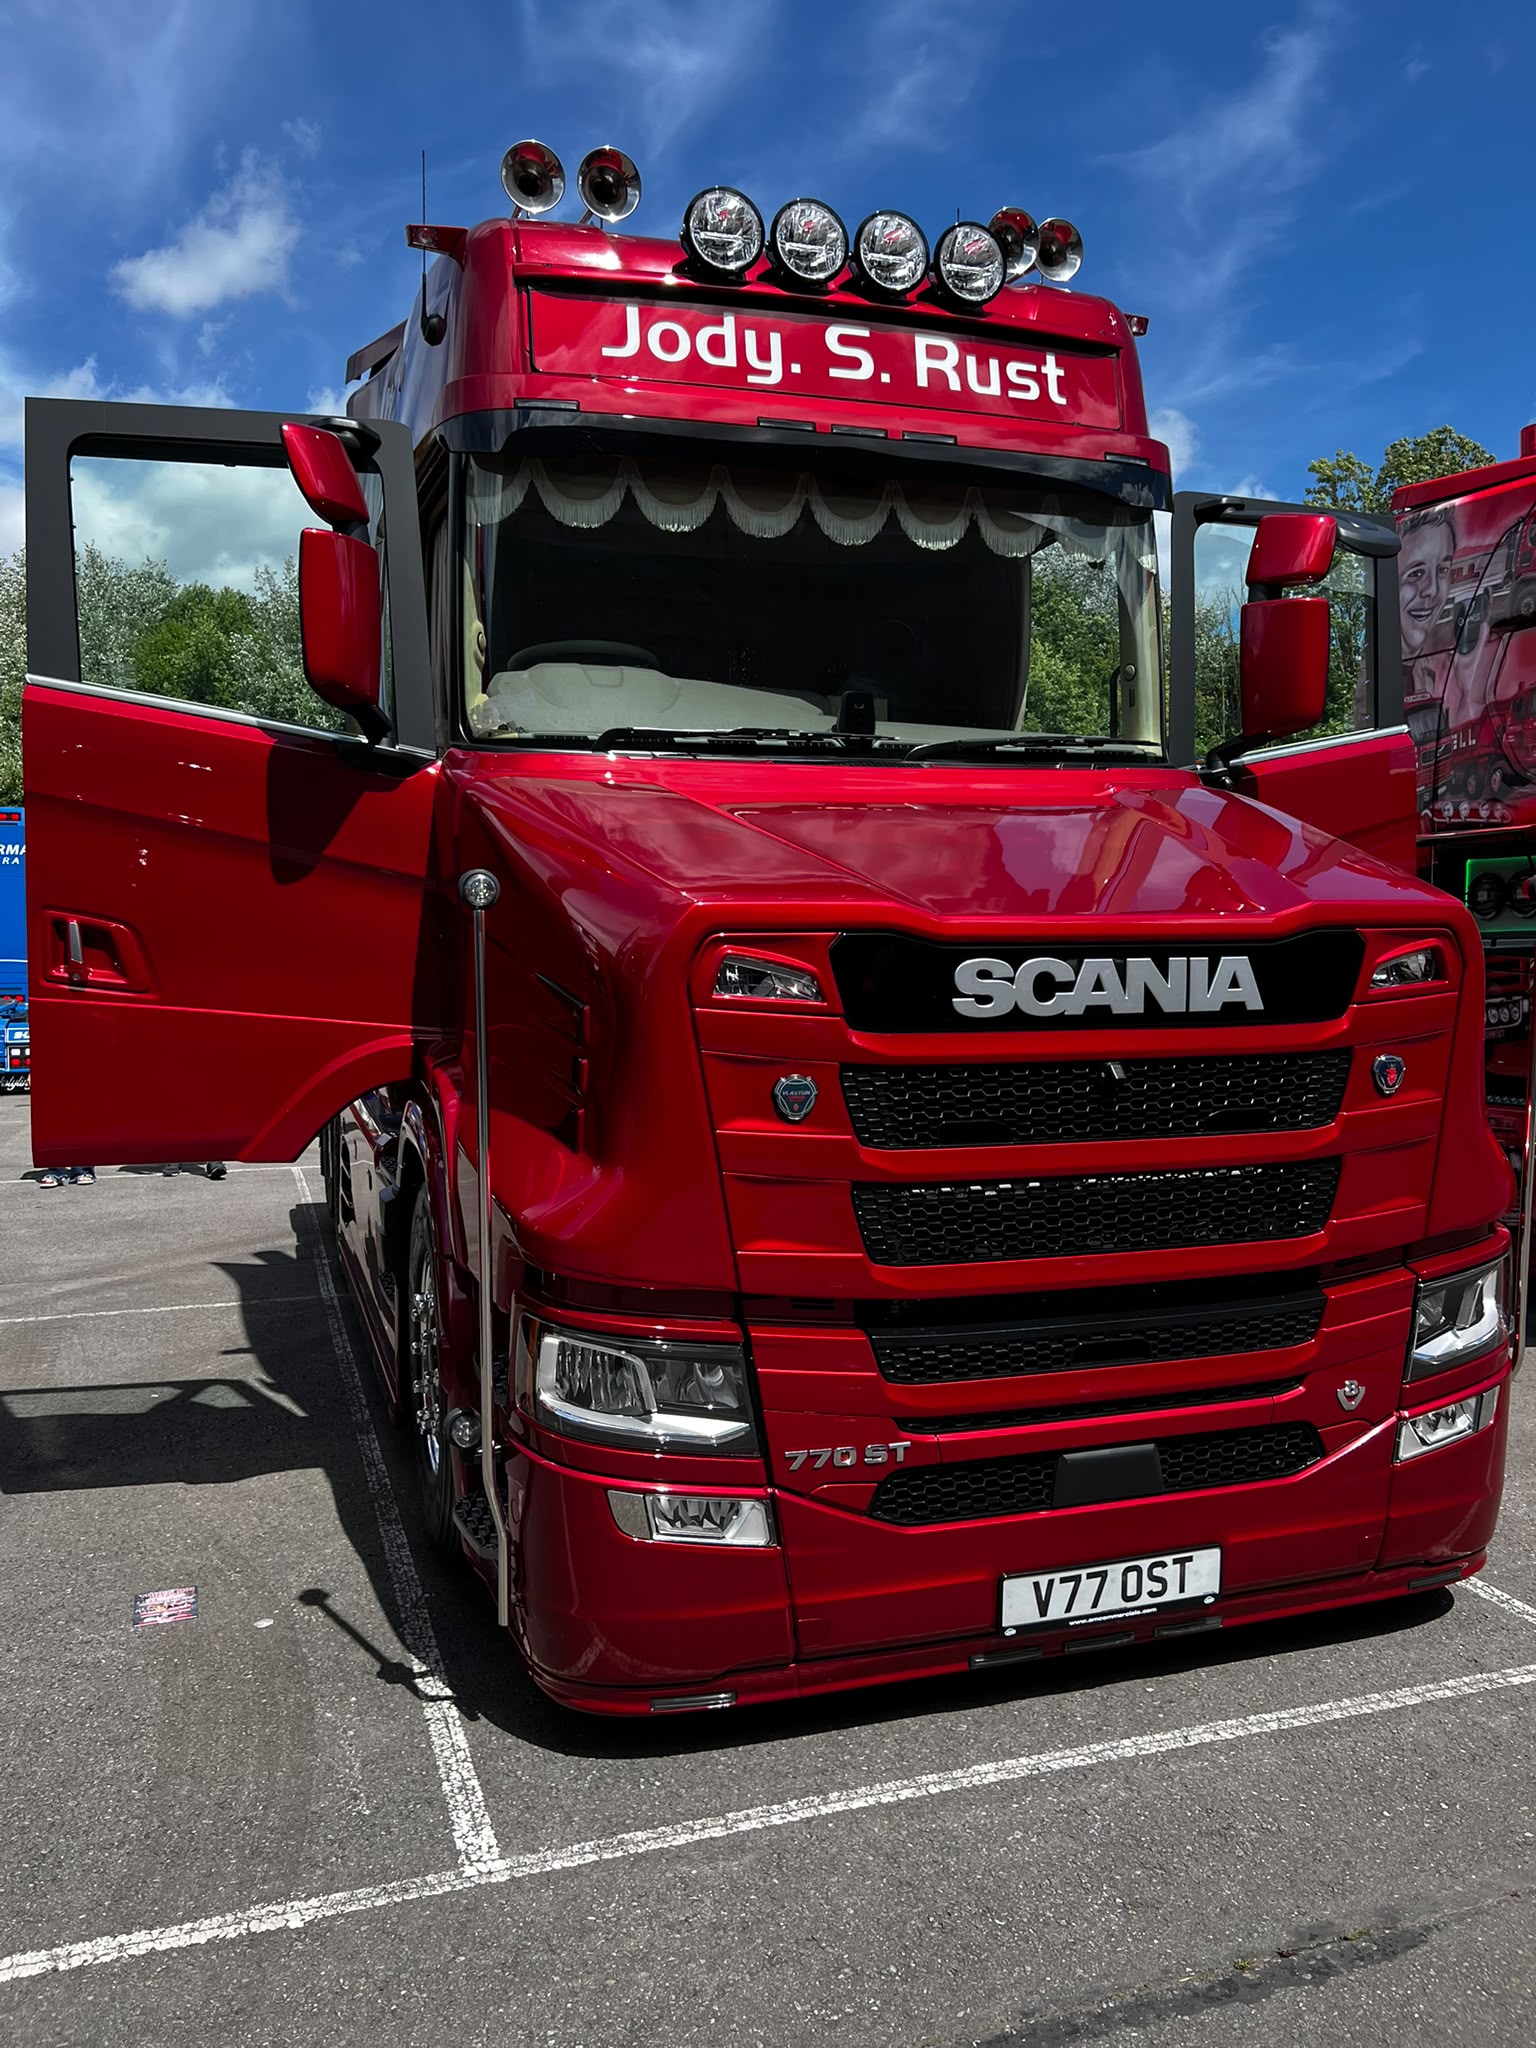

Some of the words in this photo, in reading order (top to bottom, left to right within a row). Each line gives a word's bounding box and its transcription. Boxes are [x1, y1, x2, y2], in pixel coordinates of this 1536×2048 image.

[601, 303, 802, 385] Jody.
[824, 323, 891, 384] S.
[914, 333, 1068, 406] Rust
[952, 957, 1264, 1018] SCANIA
[784, 1446, 857, 1471] 770
[863, 1441, 912, 1465] ST
[1032, 1569, 1109, 1618] V77
[1121, 1555, 1194, 1603] OST
